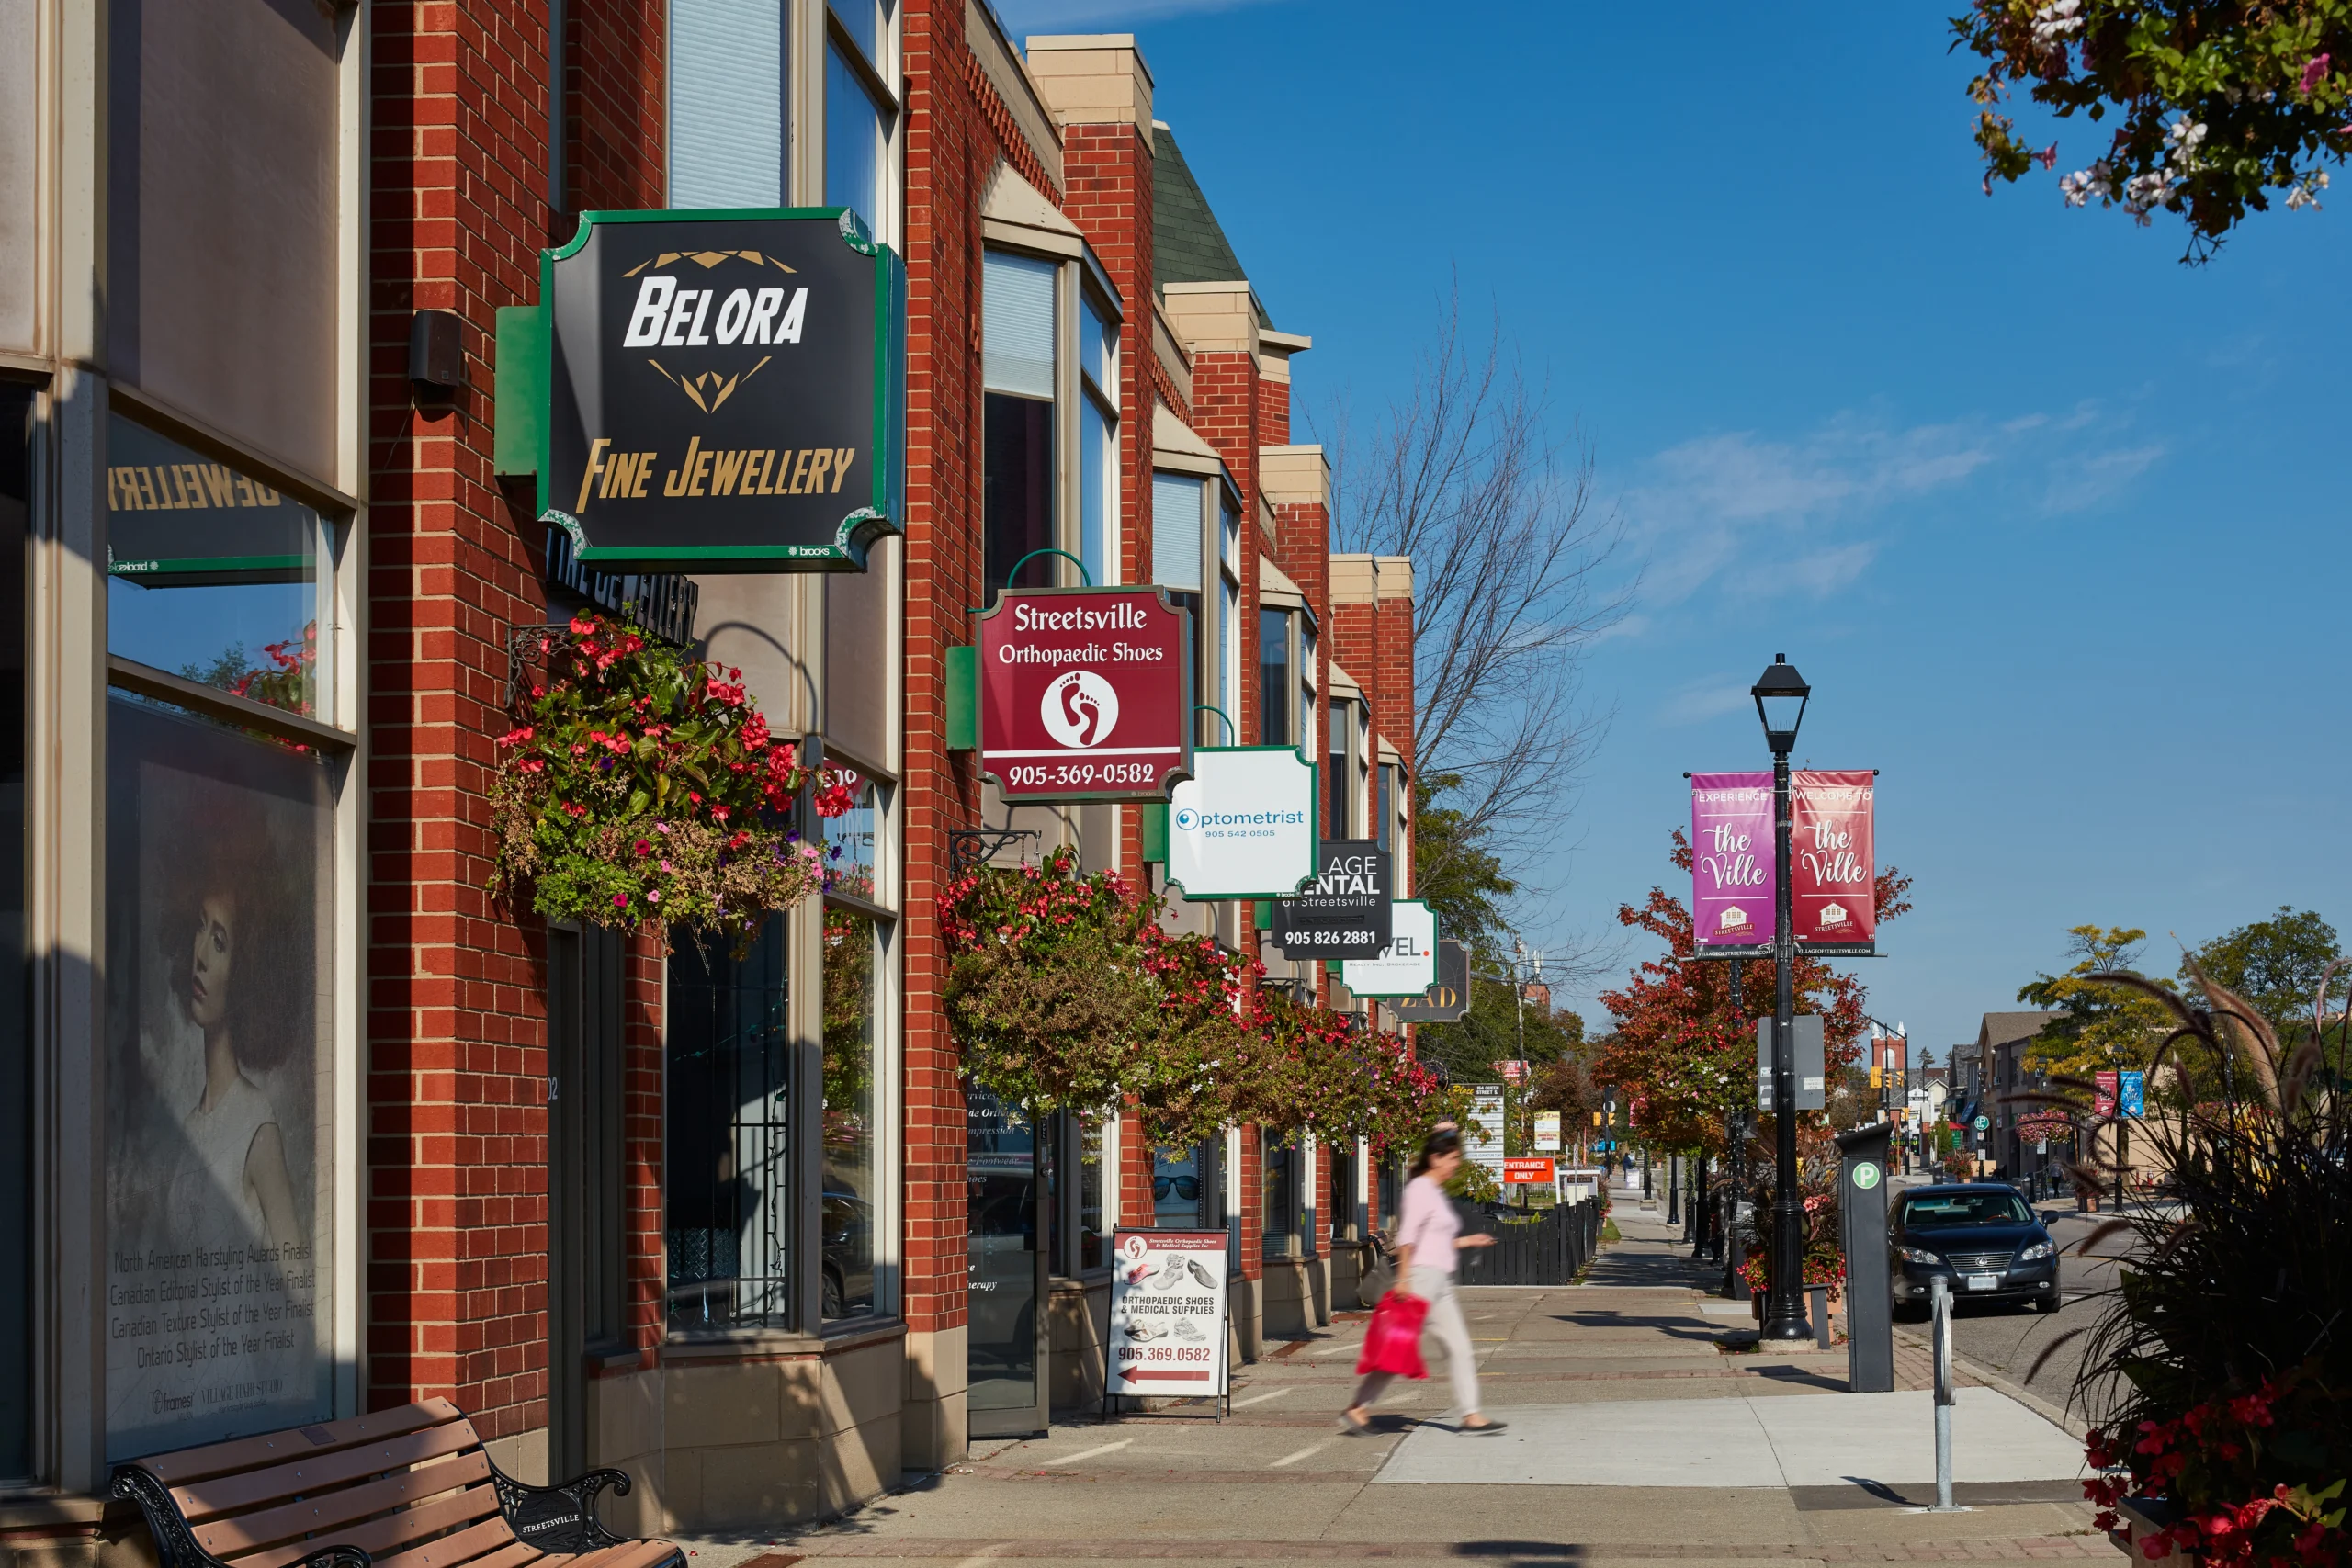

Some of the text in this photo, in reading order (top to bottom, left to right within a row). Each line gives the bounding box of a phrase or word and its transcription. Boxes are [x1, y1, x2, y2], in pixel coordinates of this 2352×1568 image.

[623, 276, 808, 348] BELORA
[575, 436, 854, 513] FINE JEWELLERY
[799, 547, 830, 556] brooks
[1014, 602, 1148, 631] Streetsville
[999, 642, 1163, 667] Orthopaedic Shoes
[1009, 763, 1155, 786] 905-369-0582
[1699, 792, 1768, 802] EXPERIENCE
[1796, 791, 1871, 801] WELCOME TO
[1176, 808, 1304, 830] Optometrist
[1702, 822, 1752, 853] the
[1803, 819, 1853, 850] the
[1301, 896, 1376, 907] Streetsville
[1714, 923, 1753, 935] STREETSVILLE
[1815, 920, 1853, 931] STREETSVILLE
[1285, 931, 1375, 944] 905 826 2881
[976, 1156, 1019, 1166] Footwear
[1860, 1167, 1874, 1185] P
[115, 1241, 312, 1273] North American Hairstyling Awards Finalist
[110, 1269, 315, 1306] Canadian Editorial Stylist of the Year Finalist
[1121, 1305, 1214, 1314] & MEDICAL SUPPLIES
[1122, 1296, 1214, 1305] ORTHOPAEDIC SHOES
[112, 1298, 314, 1339] Canadian Texture Stylist of the Year Finalist
[138, 1329, 294, 1369] Ontario Stylist of the Year Finalist
[1118, 1347, 1210, 1361] 905.369.0582
[164, 1392, 193, 1412] framesi
[201, 1385, 234, 1404] VILLAGE
[235, 1382, 254, 1399] HAIR
[522, 1514, 580, 1534] STREETSVILLE
